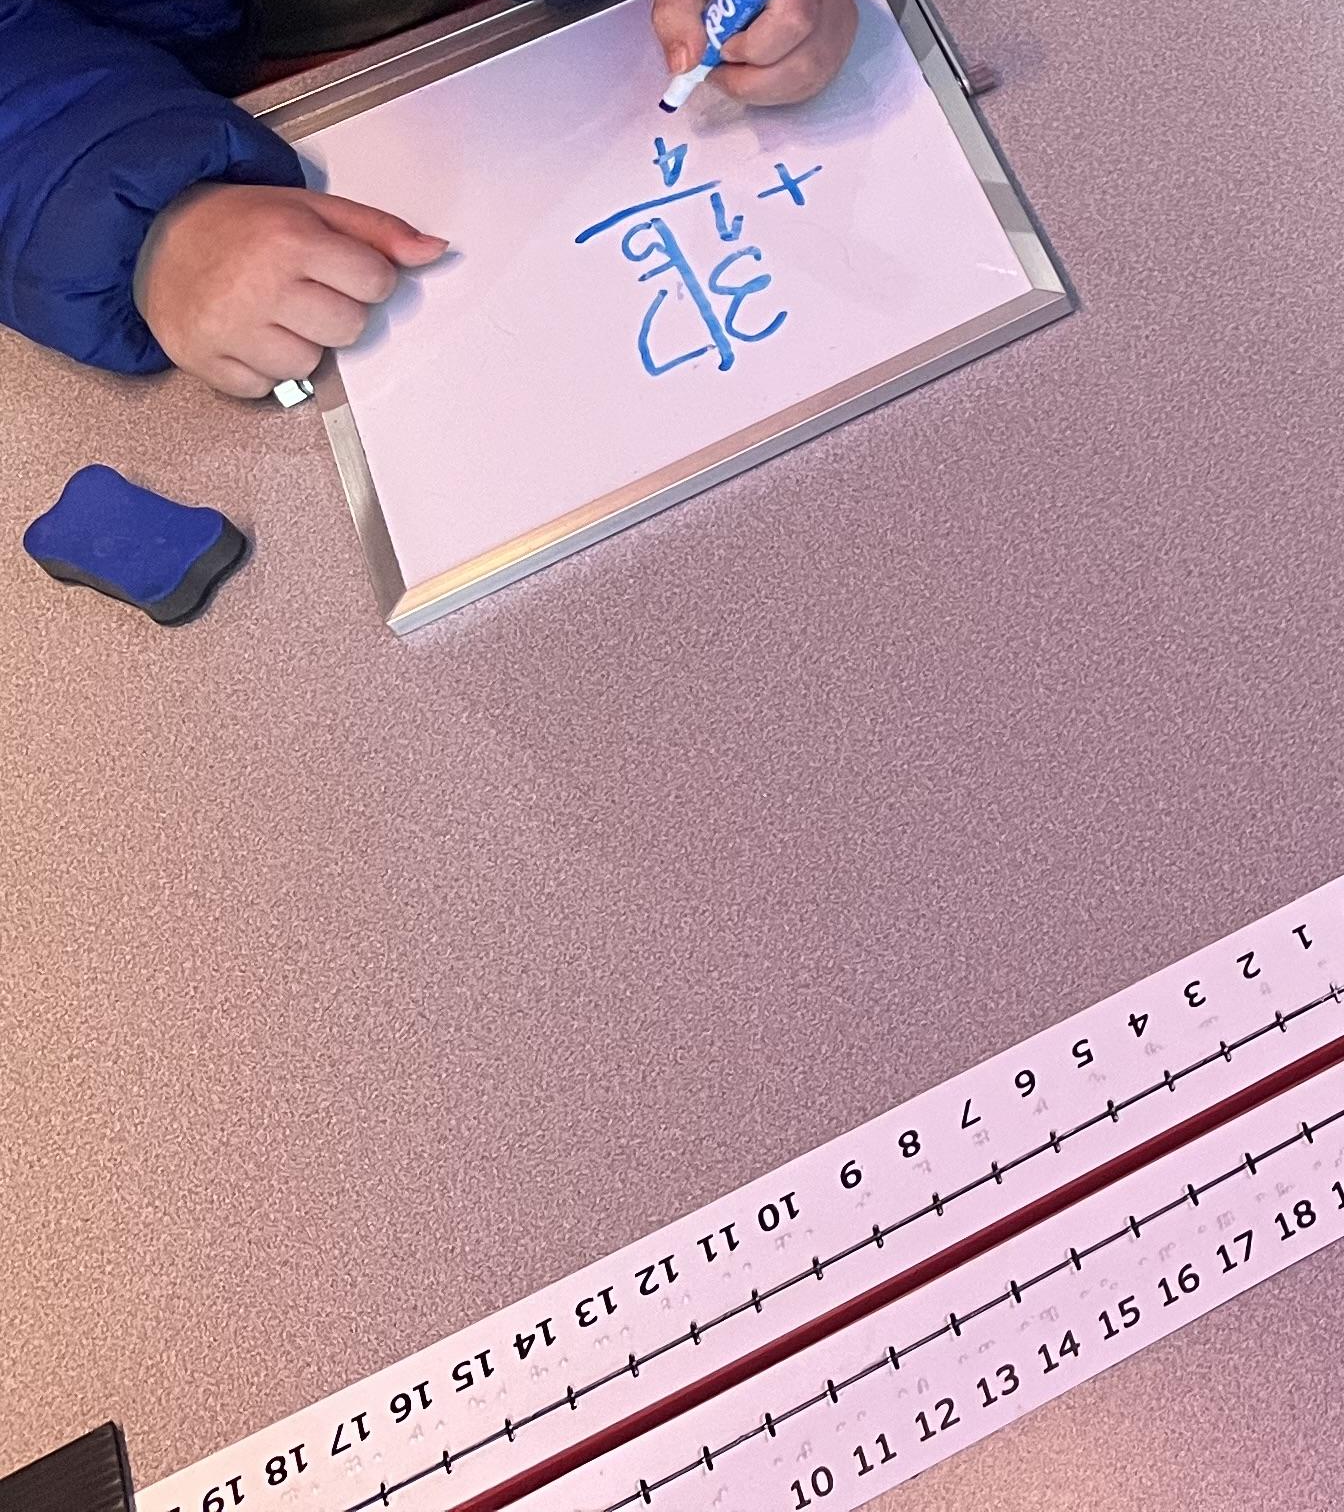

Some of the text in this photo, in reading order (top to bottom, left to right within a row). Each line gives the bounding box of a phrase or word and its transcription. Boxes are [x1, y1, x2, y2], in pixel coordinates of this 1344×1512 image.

[652, 136, 690, 188] 4
[1292, 924, 1313, 950] 1
[1236, 951, 1261, 979] 2
[1183, 980, 1206, 1008] 3
[1127, 1013, 1149, 1038] 4
[1072, 1038, 1094, 1069] 5
[1014, 1069, 1036, 1098] 6
[961, 1098, 982, 1130] 7
[898, 1129, 921, 1158] 8
[840, 1159, 862, 1189] 9
[757, 1191, 800, 1232] 10
[696, 1222, 740, 1263] 11
[634, 1254, 679, 1296] 12
[575, 1285, 618, 1328] 13
[512, 1317, 557, 1360] 14
[790, 1466, 834, 1511] 10
[853, 1433, 897, 1477] 11
[915, 1397, 961, 1442] 12
[976, 1364, 1020, 1408] 13
[1037, 1330, 1081, 1374] 14
[1098, 1295, 1140, 1341] 15
[1157, 1263, 1200, 1307] 16
[1216, 1229, 1254, 1274] 17
[1274, 1199, 1317, 1241] 18
[451, 1349, 495, 1393] 15
[389, 1380, 433, 1424] 16
[331, 1411, 371, 1457] 17
[265, 1443, 308, 1486] 18
[202, 1474, 245, 1512] 19
